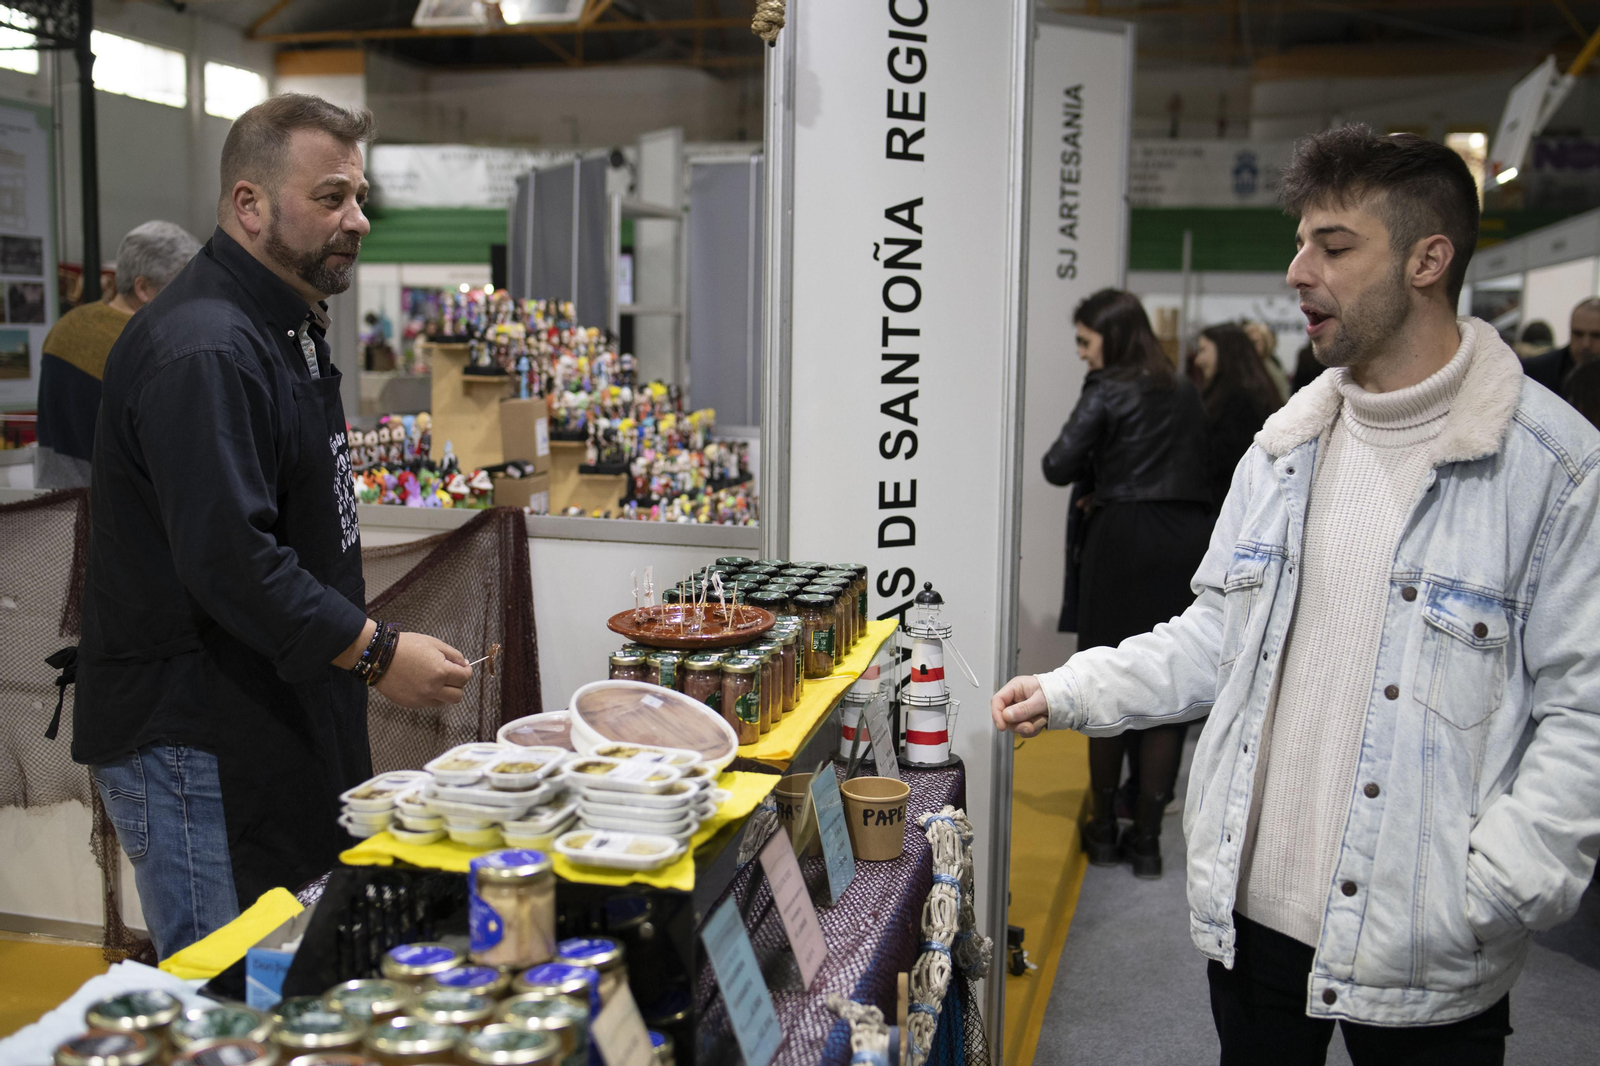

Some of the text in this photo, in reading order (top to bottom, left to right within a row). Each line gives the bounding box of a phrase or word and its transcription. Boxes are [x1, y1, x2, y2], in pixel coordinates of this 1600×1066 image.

[1056, 83, 1085, 281] SJ ARTESANIA
[873, 197, 924, 461] SANTOÑA
[878, 478, 917, 548] DE
